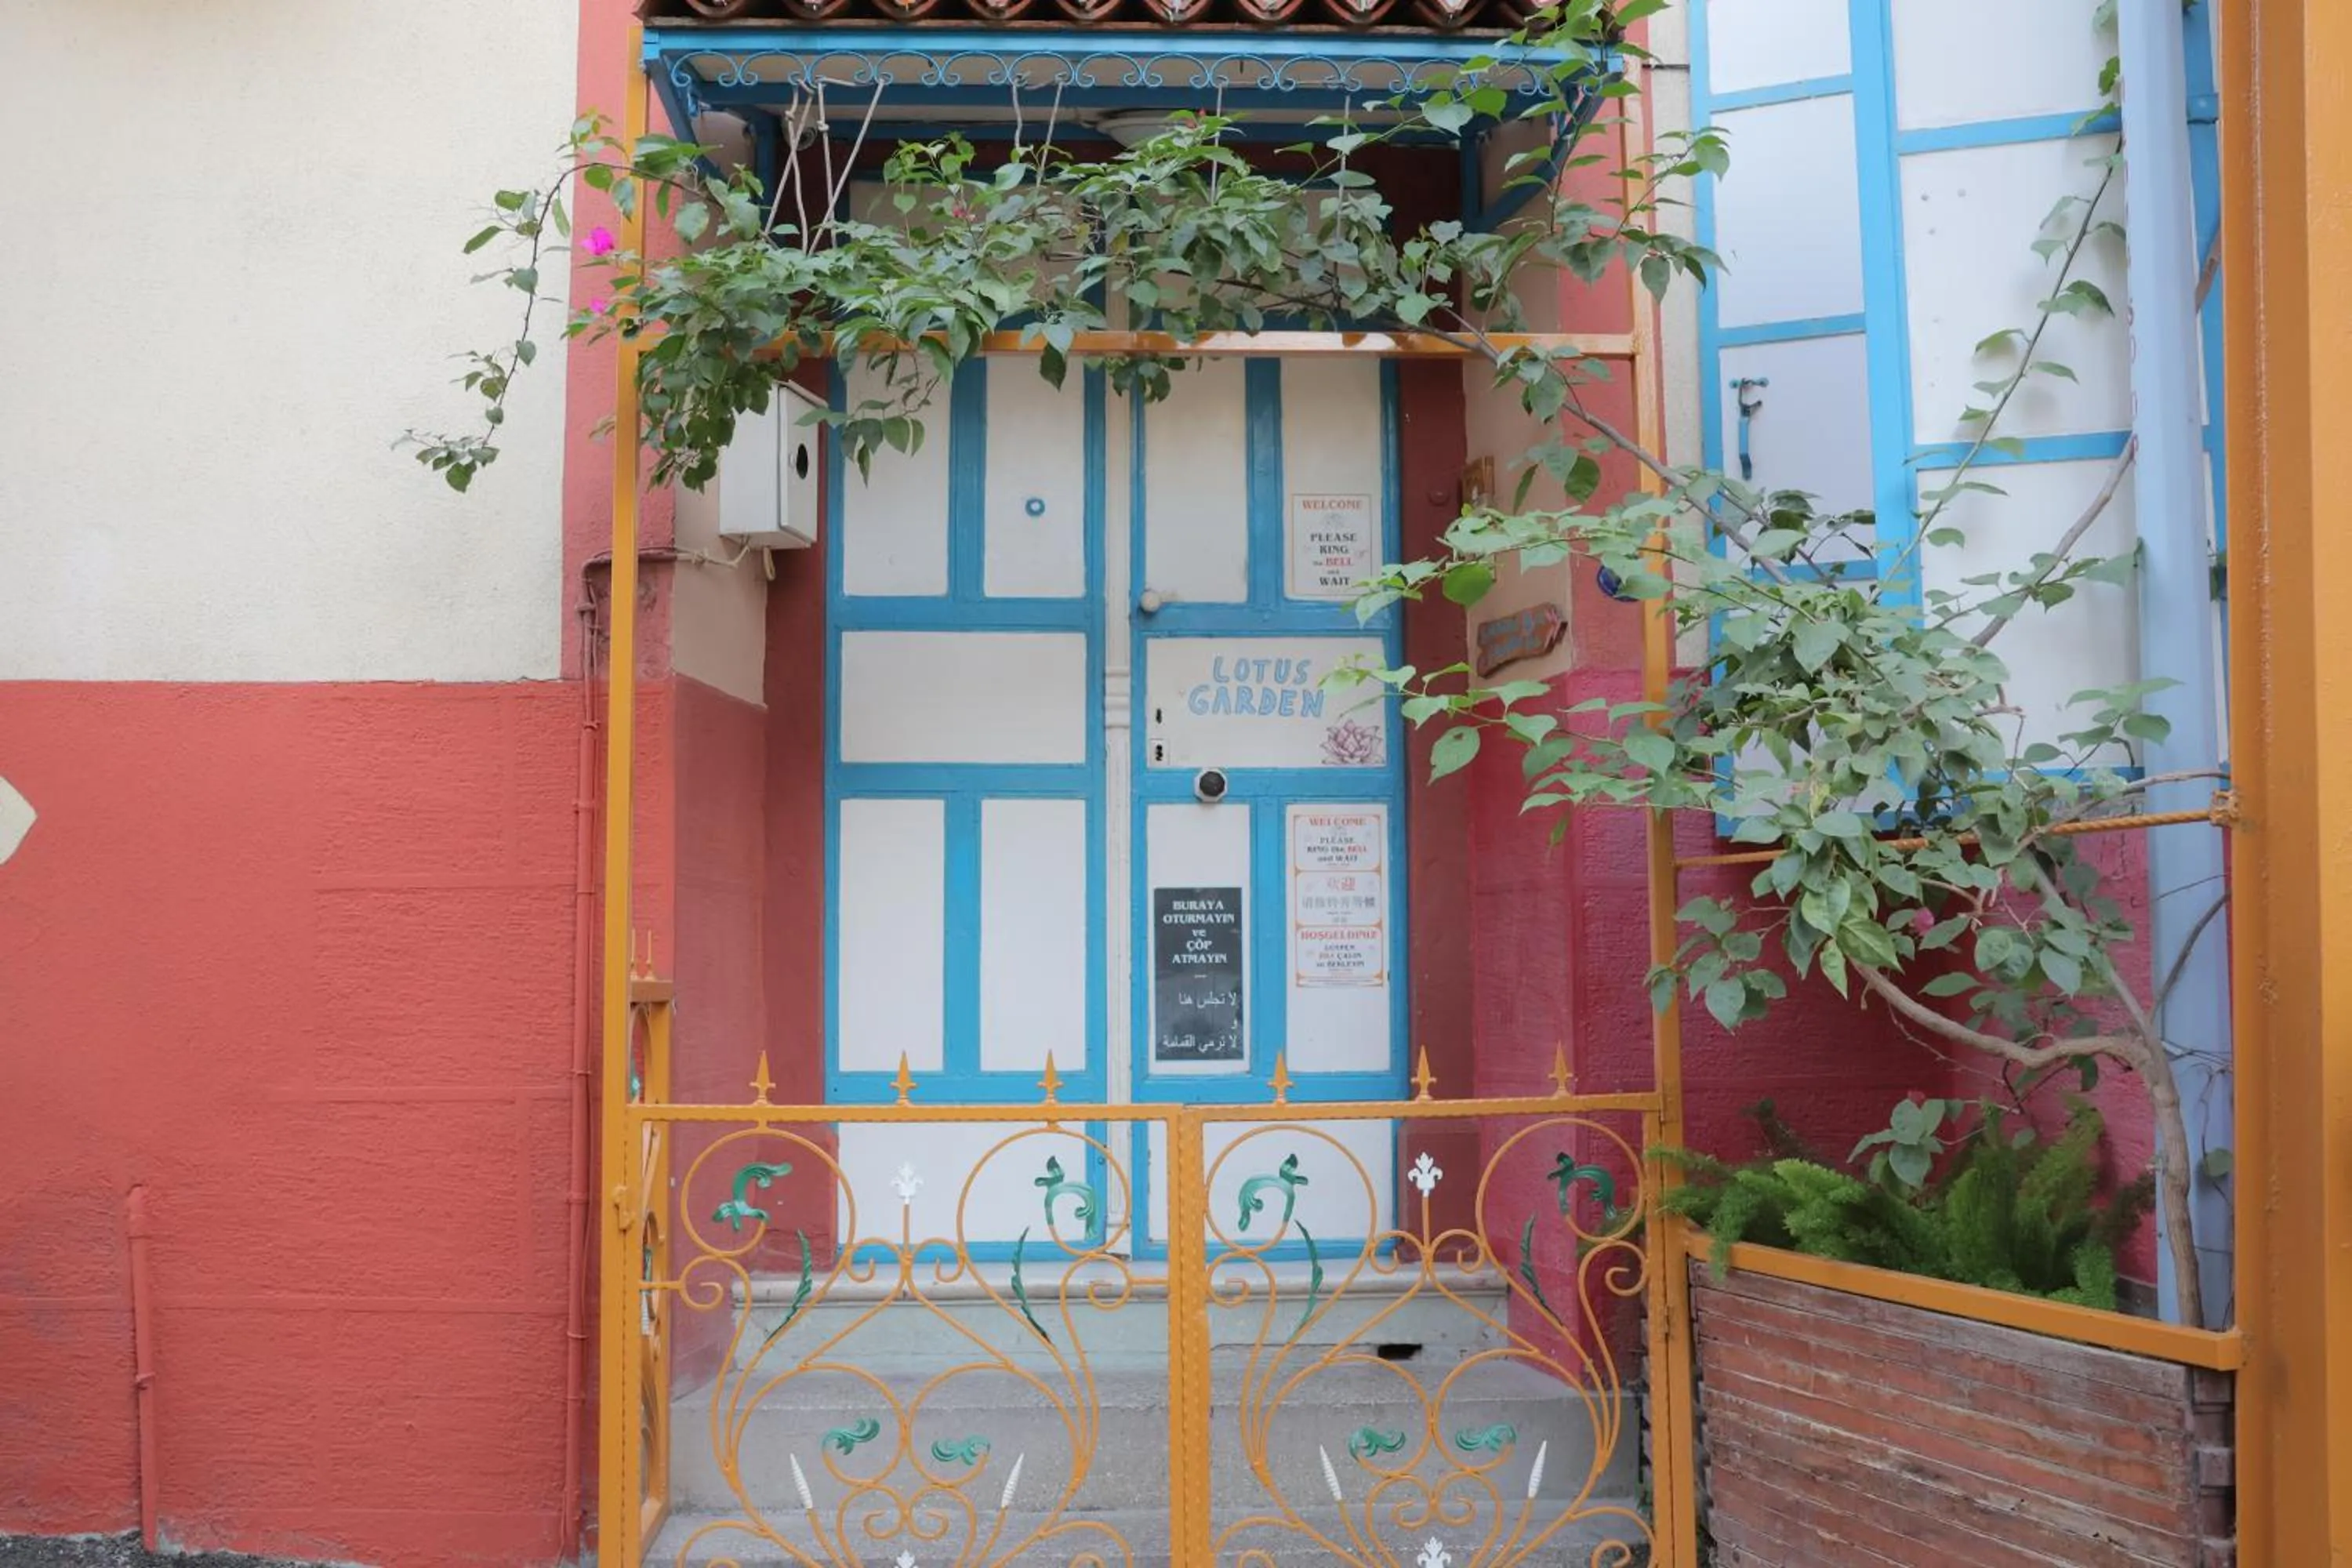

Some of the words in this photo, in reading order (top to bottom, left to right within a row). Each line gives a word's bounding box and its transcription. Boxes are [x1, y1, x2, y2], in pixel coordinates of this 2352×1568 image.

[1302, 500, 1362, 509] WELCOME
[1319, 577, 1350, 586] WAIT
[1213, 656, 1312, 684] LOTUS
[1188, 685, 1324, 717] GARDEN
[1173, 900, 1224, 910] BURAYA
[1162, 913, 1235, 924] OTURMAYIN
[1172, 953, 1228, 964] ATMAYIN
